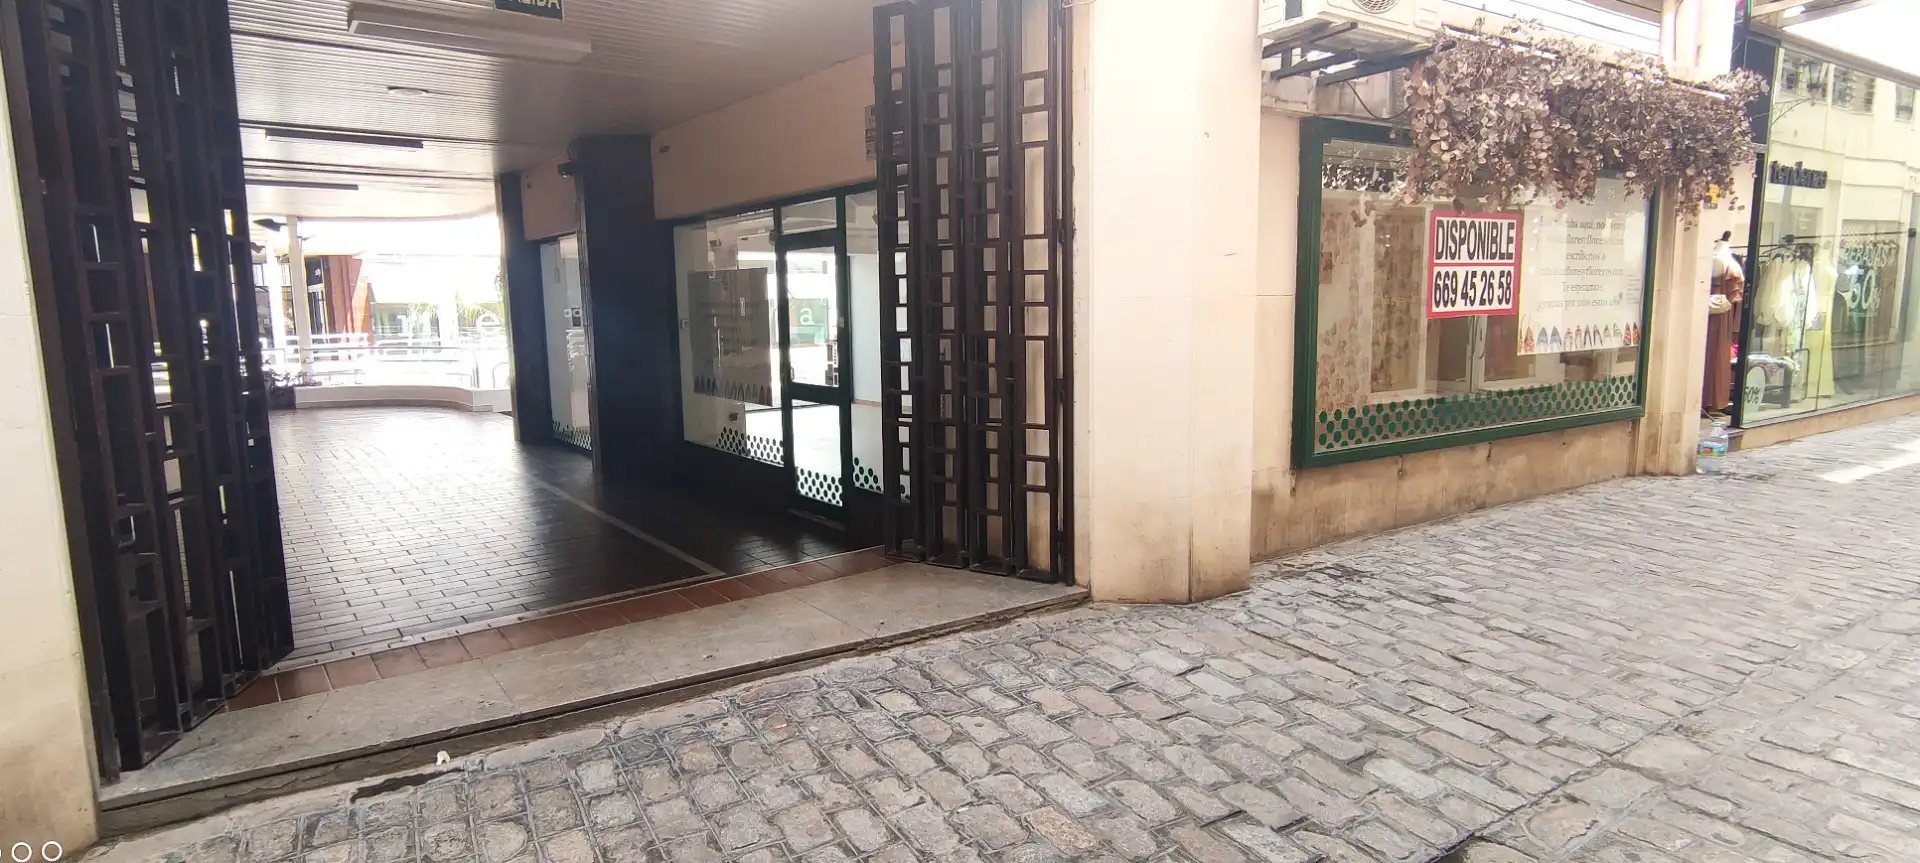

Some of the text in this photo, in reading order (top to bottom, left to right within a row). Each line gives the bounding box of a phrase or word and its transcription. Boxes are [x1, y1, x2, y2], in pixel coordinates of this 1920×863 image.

[1434, 219, 1515, 261] DISPONIBLE
[1433, 269, 1513, 309] 669 45 26 58
